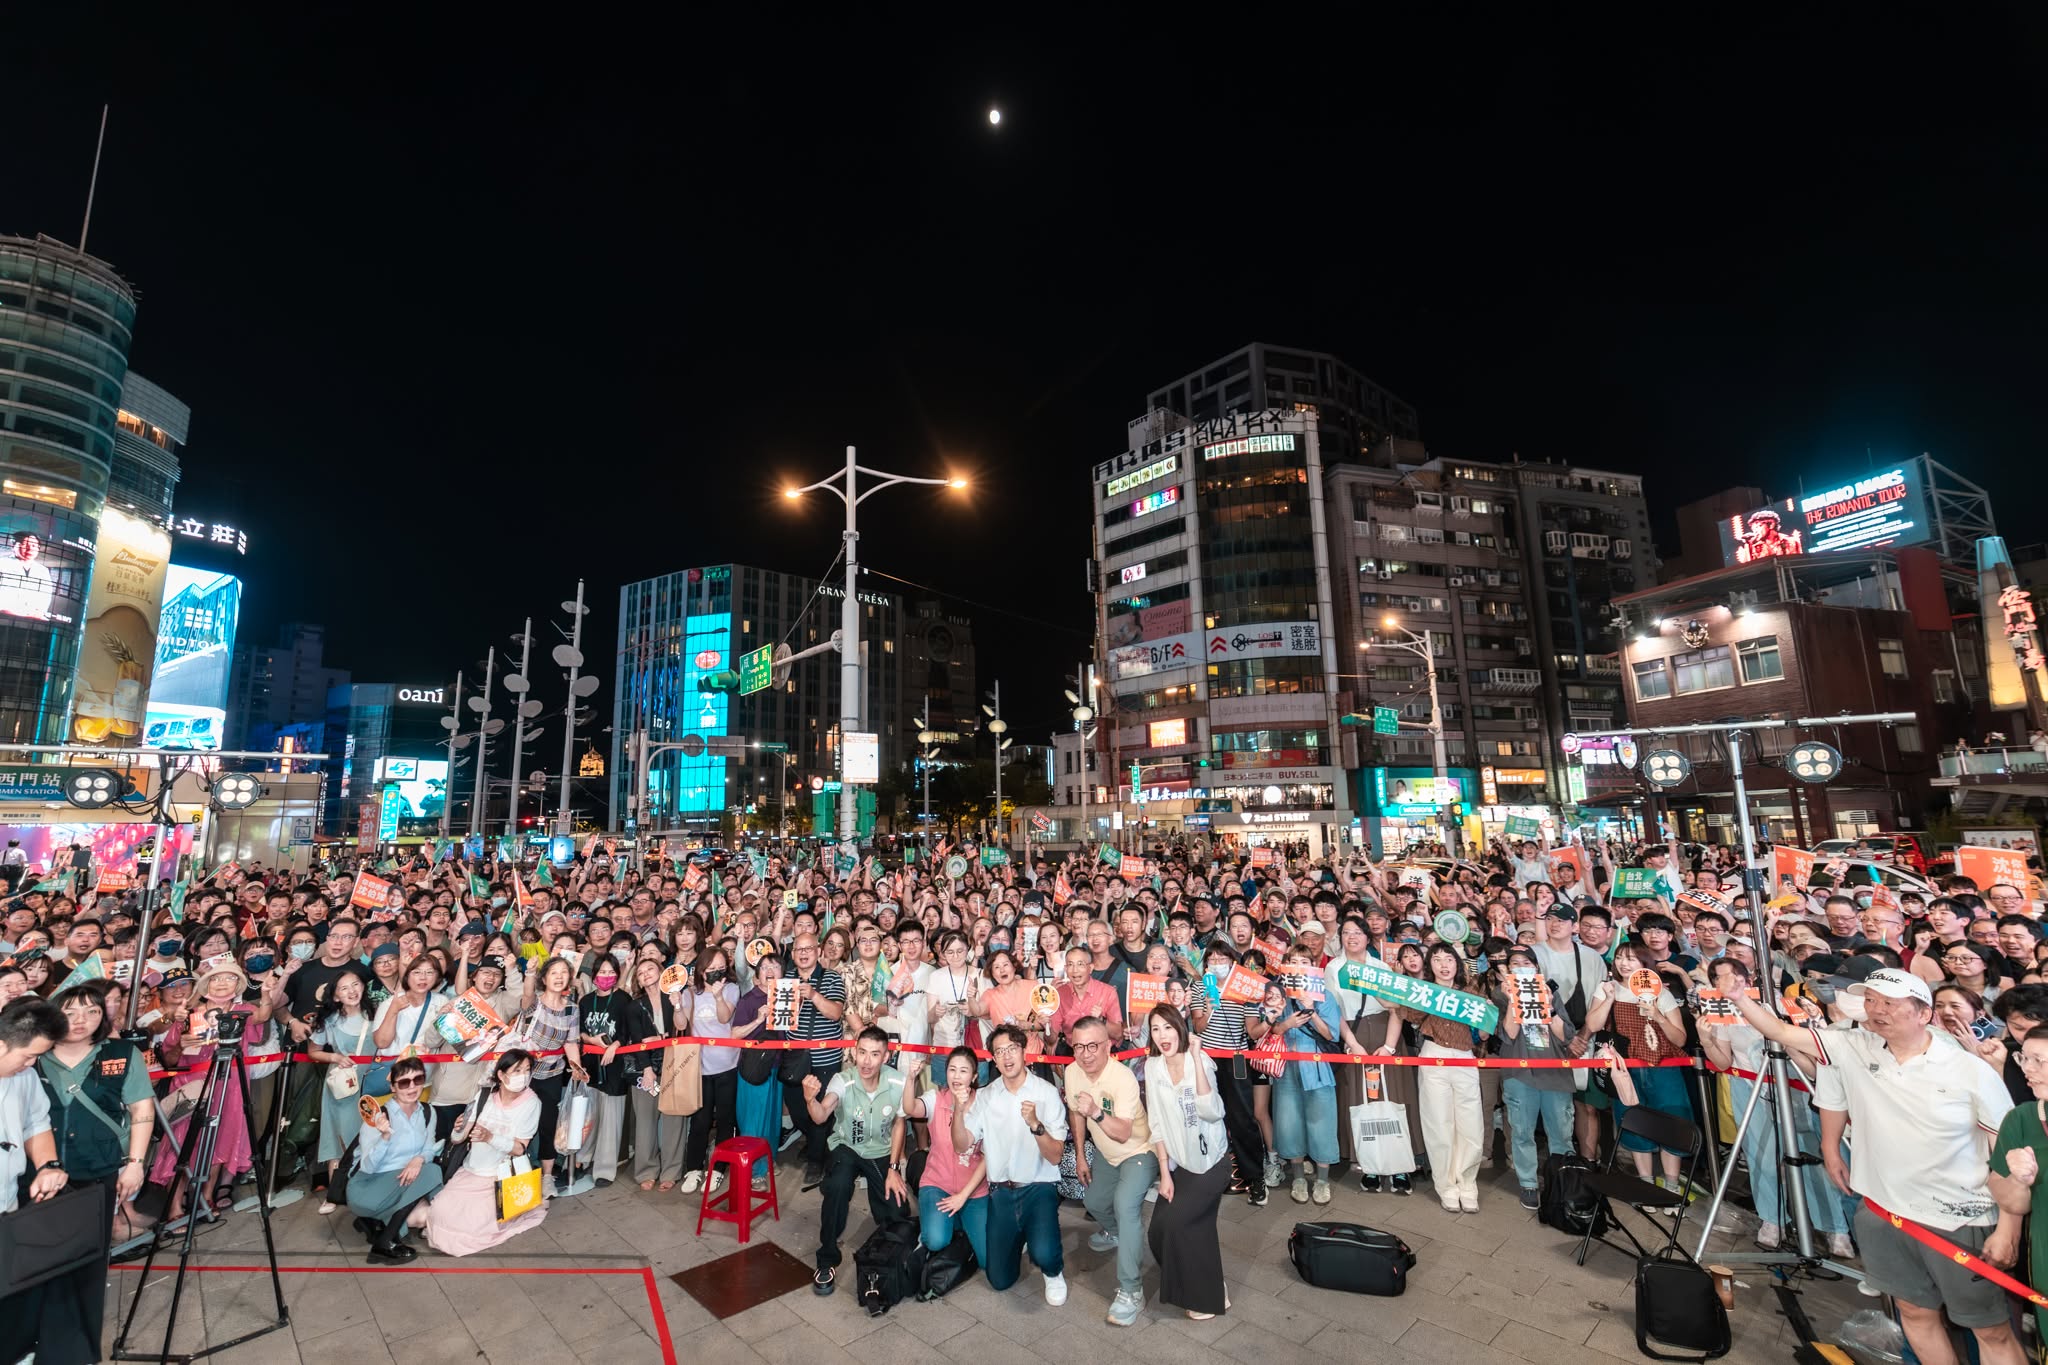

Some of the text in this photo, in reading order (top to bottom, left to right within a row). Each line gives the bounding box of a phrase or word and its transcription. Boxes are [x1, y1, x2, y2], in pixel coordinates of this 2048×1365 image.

[1801, 469, 1905, 512] BRUNO MARS
[1805, 508, 1826, 525] THE
[1825, 493, 1877, 519] ROMANTIC
[1876, 483, 1907, 504] TOUR
[117, 551, 155, 571] Budweiser
[818, 585, 889, 606] GRAN FRÉSA
[1290, 625, 1316, 638] 密室
[1150, 644, 1172, 664] 6/F
[1291, 638, 1317, 651] 逃脫
[0, 772, 62, 787] 西門站
[24, 788, 61, 796] STATION
[192, 813, 201, 824] 6
[1254, 812, 1310, 822] 2nd STREET
[1626, 871, 1643, 881] 台北
[1795, 856, 1806, 888] 沈伯
[2011, 858, 2027, 892] 你的市
[1132, 979, 1165, 990] 你的市長
[1281, 972, 1325, 992] 洋流
[1639, 970, 1652, 989] 洋流
[1131, 988, 1166, 1002] 沈伯洋
[1230, 980, 1265, 1000] 沈伯洋
[1347, 964, 1488, 1024] 你的市長 沈伯洋
[1514, 978, 1548, 1021] 洋流
[456, 998, 489, 1030] 沈伯洋
[772, 986, 796, 1027] 洋流
